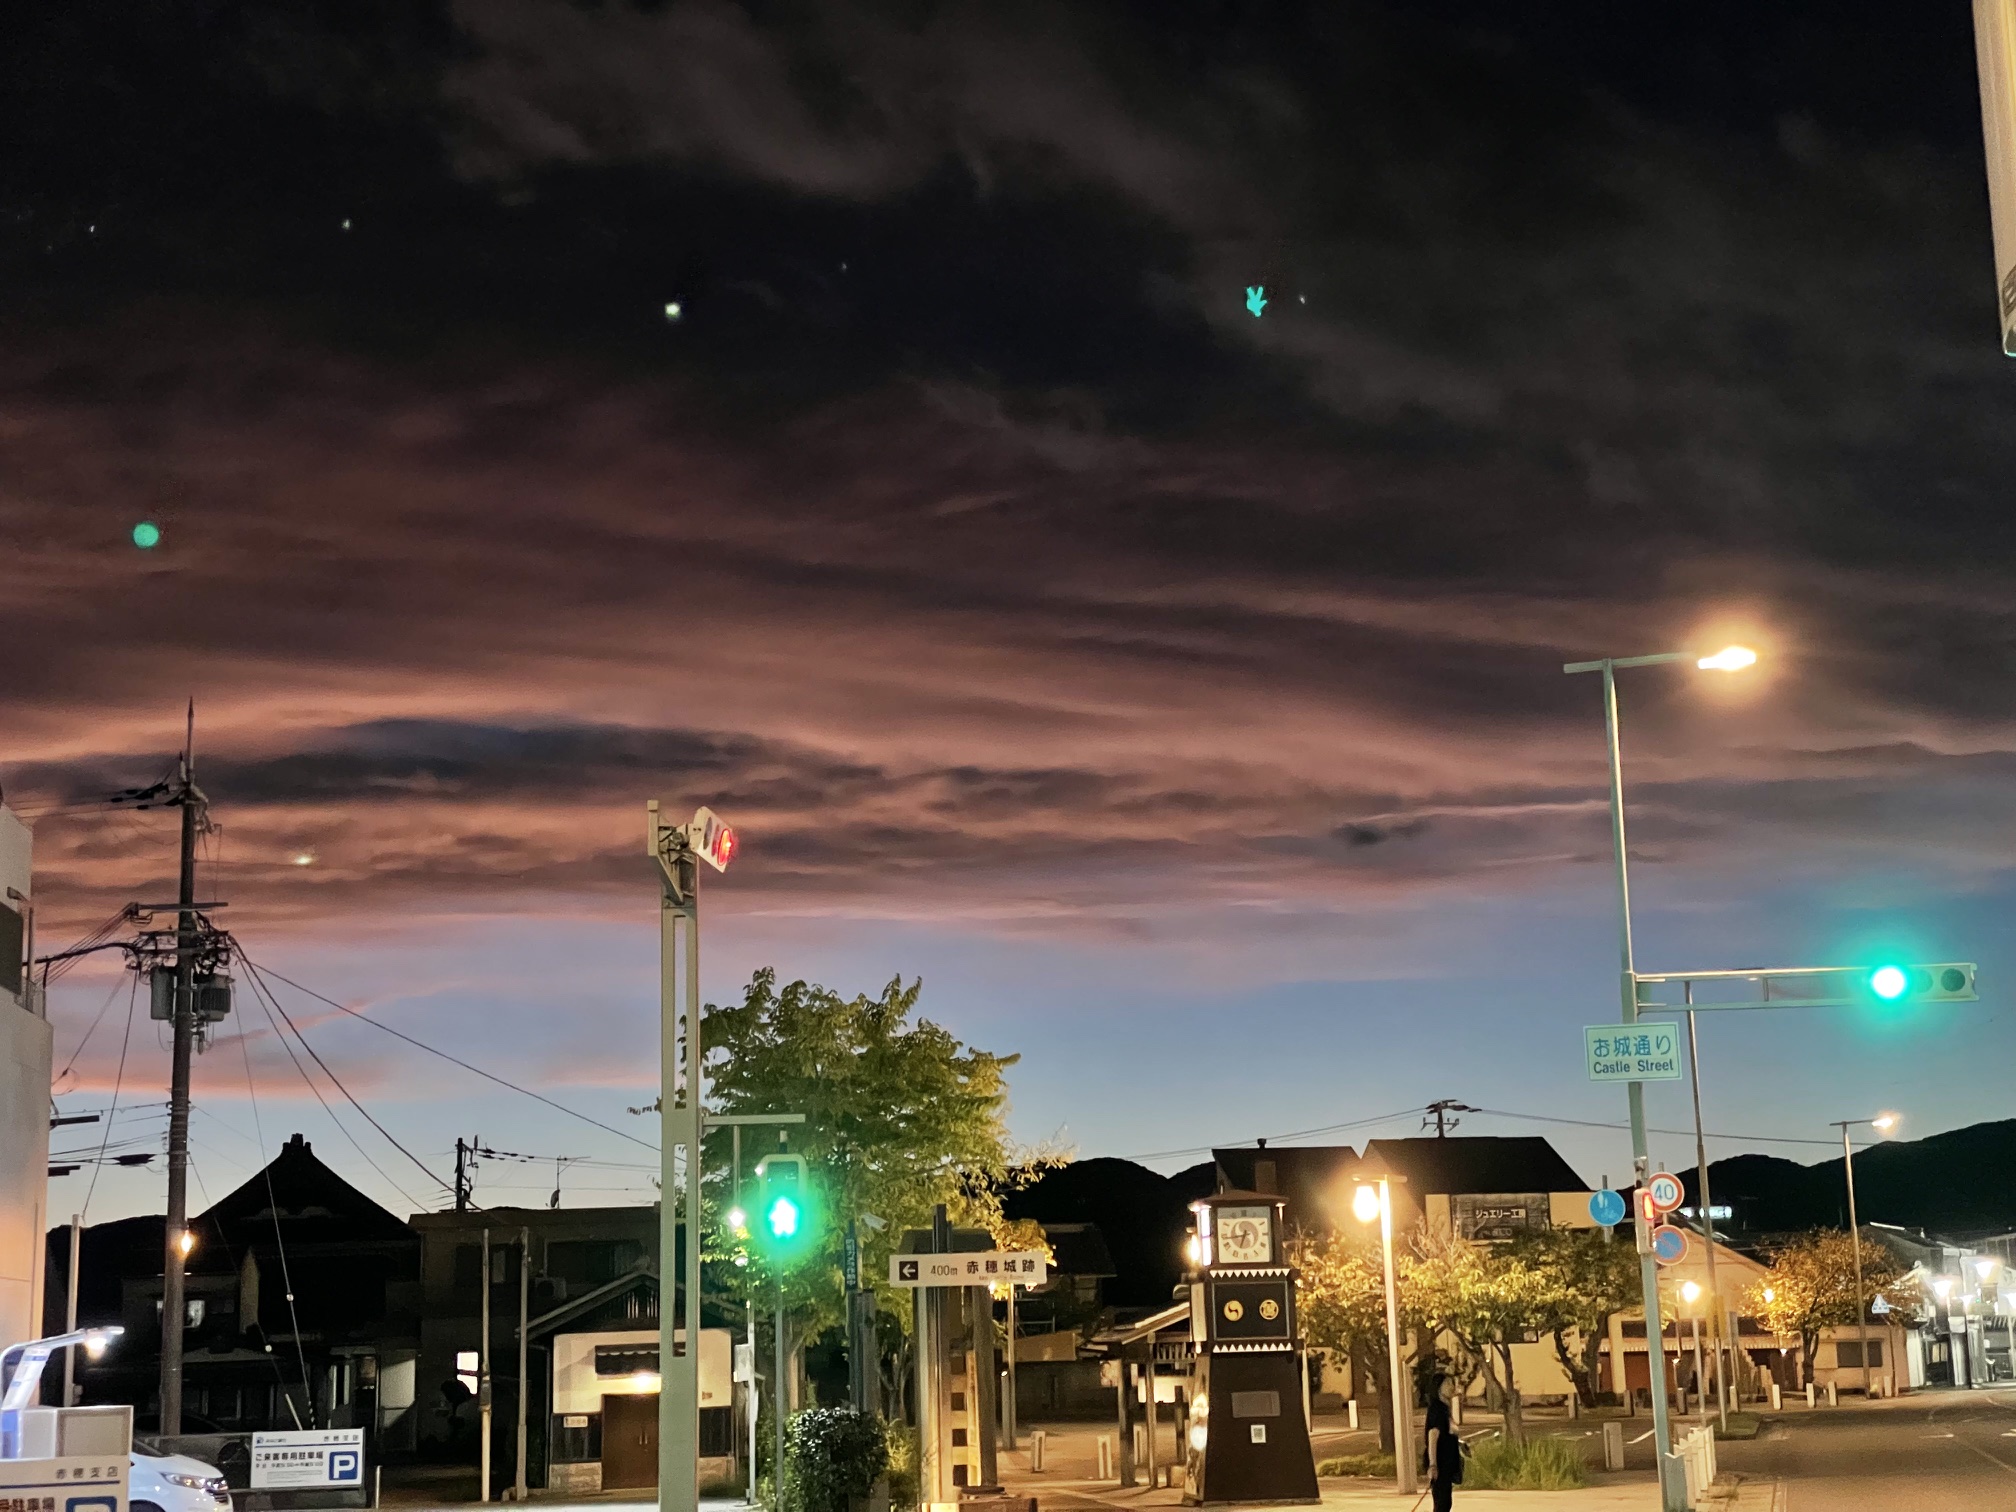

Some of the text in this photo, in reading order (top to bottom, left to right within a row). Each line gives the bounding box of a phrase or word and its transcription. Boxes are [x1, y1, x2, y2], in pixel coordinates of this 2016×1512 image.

[1593, 1035, 1671, 1058] お城通り
[1593, 1058, 1674, 1074] Castle Street
[1654, 1183, 1675, 1201] 40
[930, 1258, 1036, 1276] 400m 赤穂城跡
[333, 1455, 356, 1478] P
